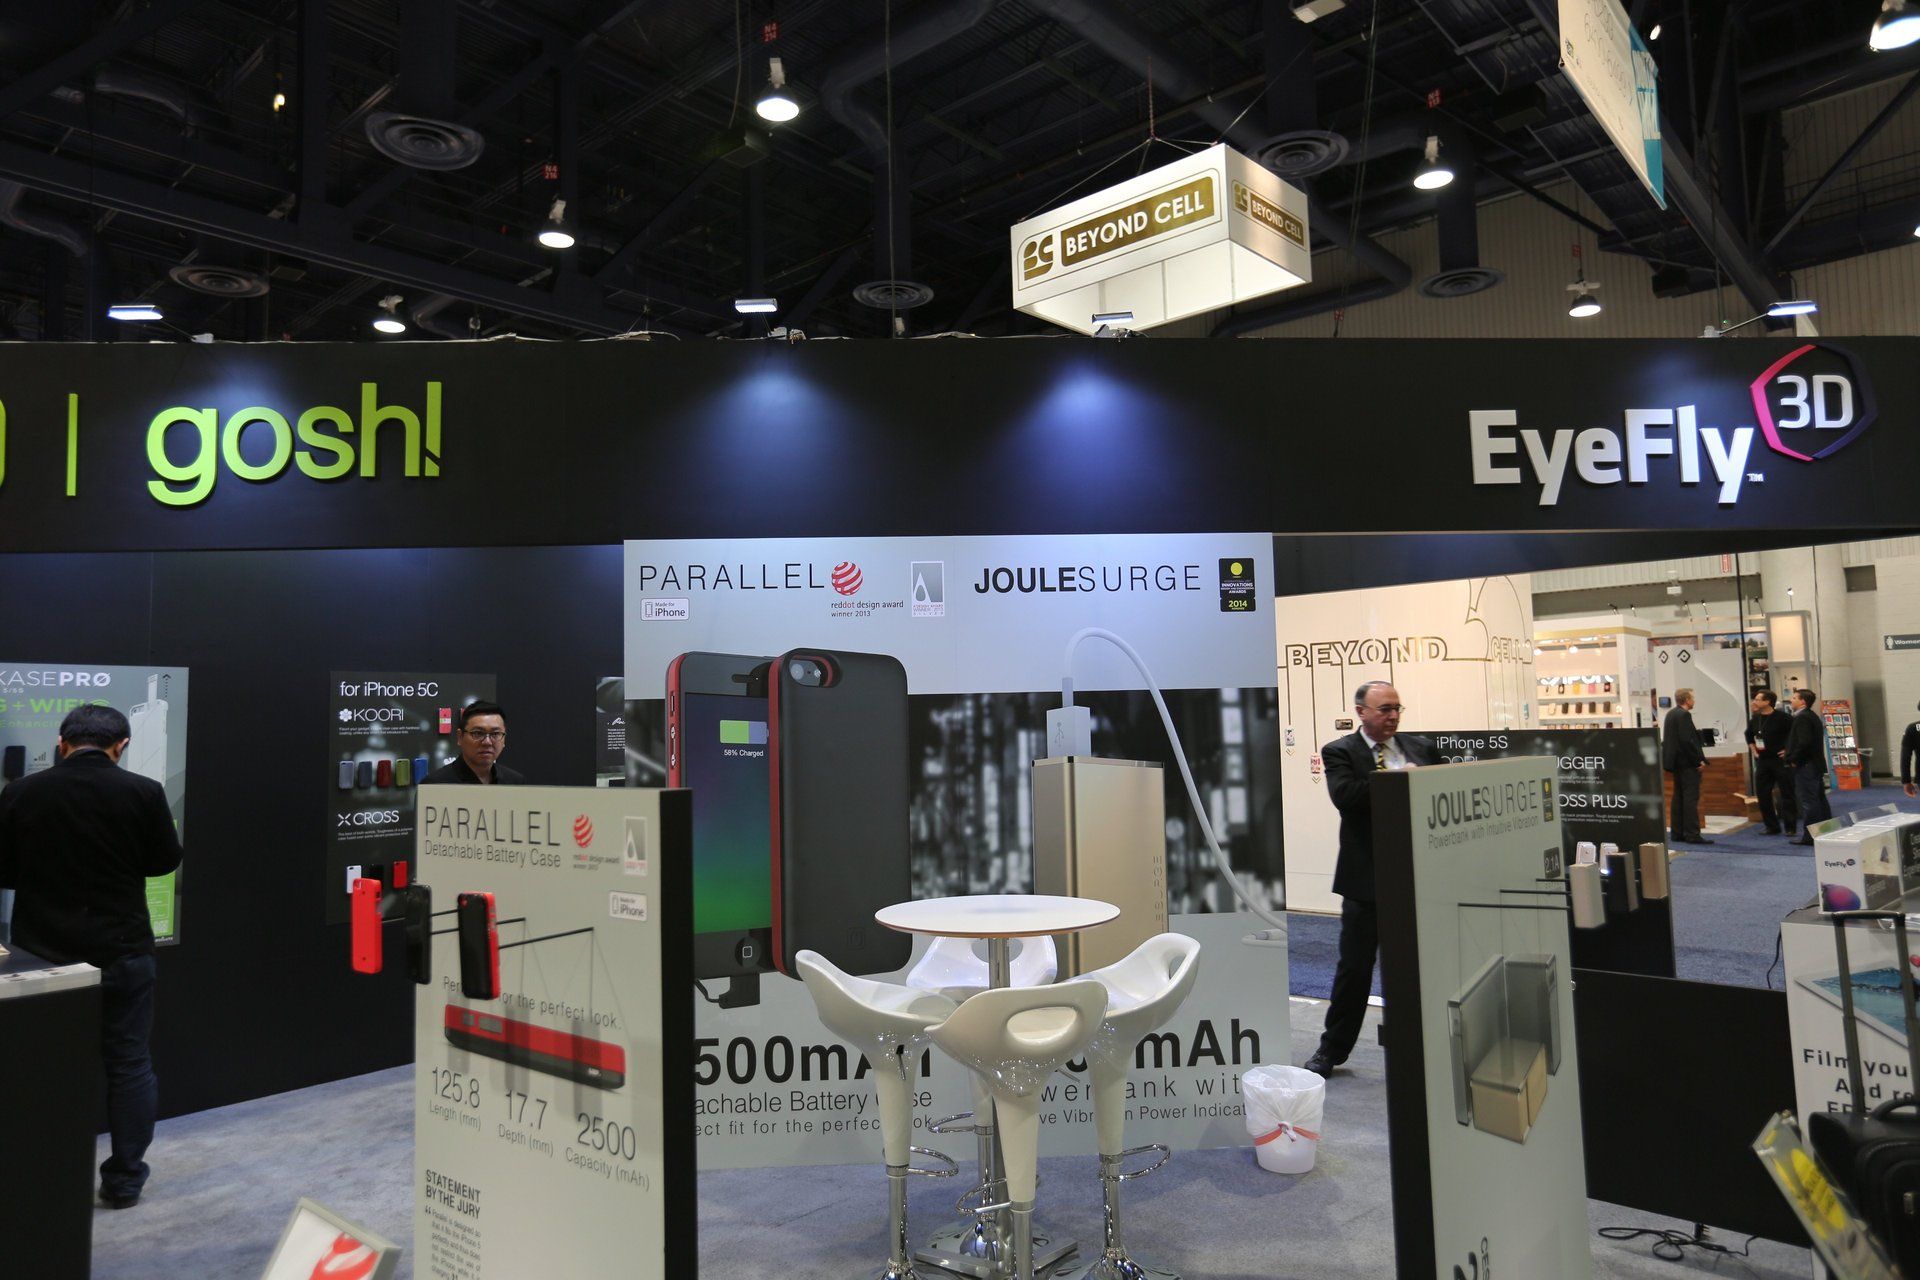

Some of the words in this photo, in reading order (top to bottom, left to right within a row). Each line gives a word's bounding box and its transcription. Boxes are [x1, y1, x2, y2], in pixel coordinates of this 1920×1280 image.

[1065, 211, 1148, 257] BEYOND
[1154, 190, 1204, 225] CELL
[1251, 198, 1284, 230] BEYOND
[1284, 219, 1302, 240] CELL
[1776, 374, 1855, 430] 3D
[146, 380, 443, 507] gosh!
[1468, 404, 1755, 506] EyeFly
[640, 563, 825, 591] PARALLEL
[974, 565, 1201, 594] JOULESURGE
[655, 607, 686, 617] iPhone
[856, 600, 880, 610] design
[882, 600, 904, 608] award
[1228, 600, 1248, 608] 2014
[1285, 636, 1448, 669] BEYOND
[339, 681, 361, 697] for
[364, 681, 415, 697] iPhone
[417, 682, 439, 697] 5C
[353, 708, 404, 721] KOORI
[739, 749, 764, 758] Charged
[1436, 736, 1484, 749] iPhone
[1489, 735, 1508, 749] 5S
[1427, 780, 1538, 830] JOULESURGE
[1558, 793, 1588, 808] OSS
[1592, 794, 1628, 809] PLUS
[353, 809, 400, 826] CROSS
[425, 805, 561, 847] PARALLEL
[425, 840, 483, 861] Detachable
[486, 844, 527, 869] Battery
[530, 848, 561, 868] Case
[1427, 830, 1469, 850] Powerbank
[620, 903, 645, 917] iPhone
[443, 975, 461, 993] Per
[518, 993, 536, 1010] the
[540, 1000, 586, 1022] perfect
[431, 1066, 481, 1110] 125.8
[1195, 1072, 1240, 1096] wit
[1835, 1078, 1882, 1099] Ad
[429, 1099, 456, 1120] Length
[459, 1110, 482, 1132] (mm)
[505, 1089, 548, 1131] 17.7
[696, 1091, 782, 1115] achable
[790, 1090, 868, 1115] Battery
[1139, 1105, 1187, 1120] Power
[1194, 1102, 1247, 1118] Indicat
[499, 1123, 527, 1146] Depth
[529, 1134, 554, 1157] (mm)
[577, 1112, 636, 1161] 2500
[696, 1121, 720, 1136] ect
[729, 1120, 745, 1134] fit
[753, 1119, 777, 1134] for
[786, 1118, 813, 1133] the
[822, 1116, 881, 1135] perfec
[565, 1146, 613, 1180] Capacity
[616, 1164, 650, 1192] (mAh)
[425, 1168, 481, 1204] STATEMENT
[426, 1184, 437, 1200] BY
[438, 1188, 455, 1209] THE
[457, 1198, 481, 1220] JURY
